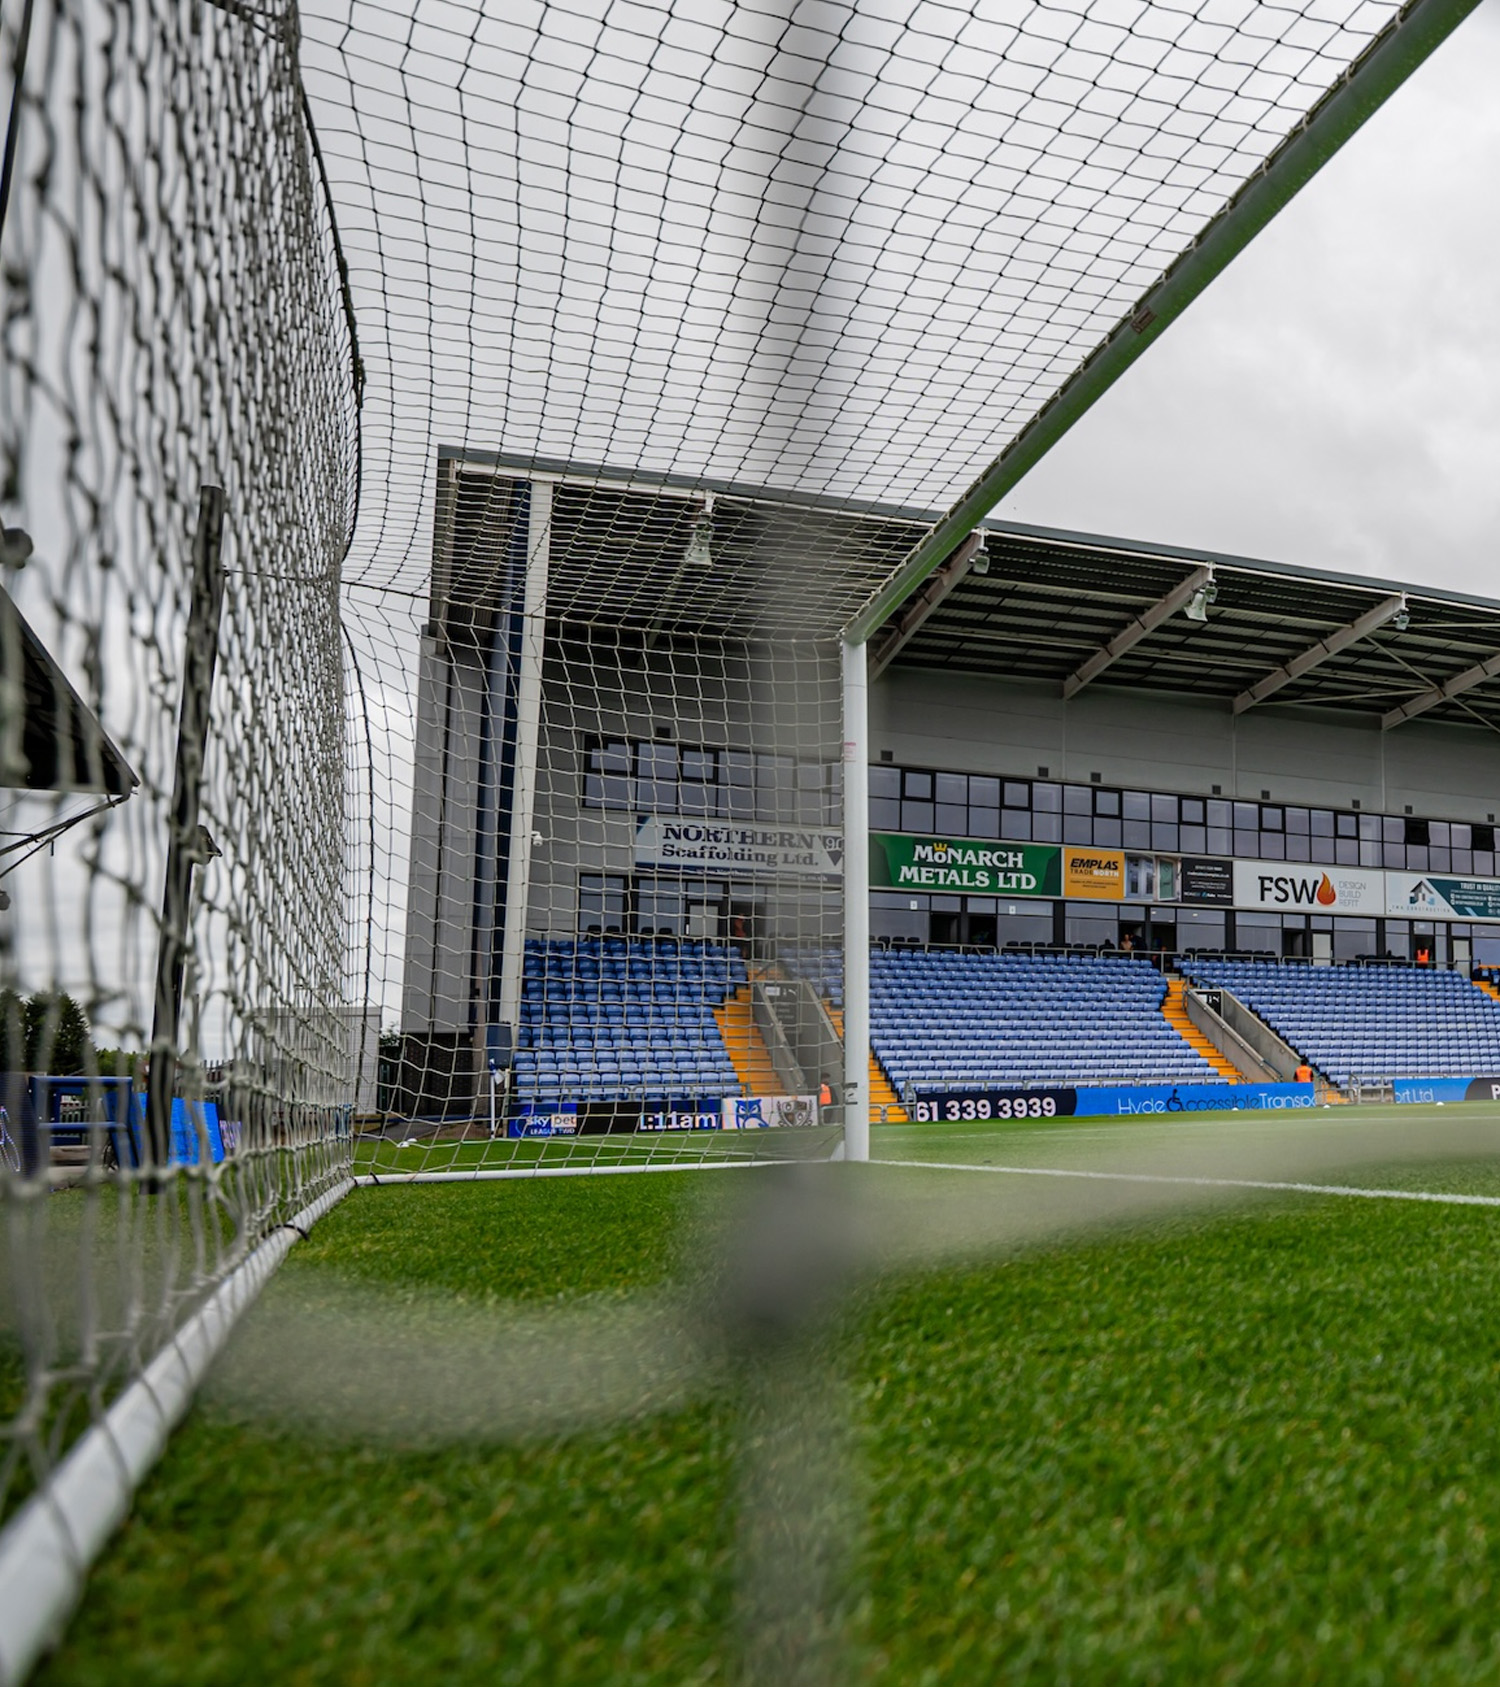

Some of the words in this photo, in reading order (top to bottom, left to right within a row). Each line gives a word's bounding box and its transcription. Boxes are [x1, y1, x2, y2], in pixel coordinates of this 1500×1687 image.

[662, 824, 815, 849] NORTHERN
[662, 844, 777, 867] Scaffolding
[782, 853, 819, 866] Ltd.
[1070, 858, 1119, 871] EMPLAS
[898, 865, 990, 888] METALS
[997, 872, 1037, 890] LTD
[1338, 880, 1367, 890] DESIGN
[1257, 875, 1320, 905] FSW
[1338, 890, 1361, 899] BUILD
[1413, 1088, 1434, 1103] Ltd
[946, 1100, 992, 1121] 339
[997, 1096, 1057, 1119] 3939
